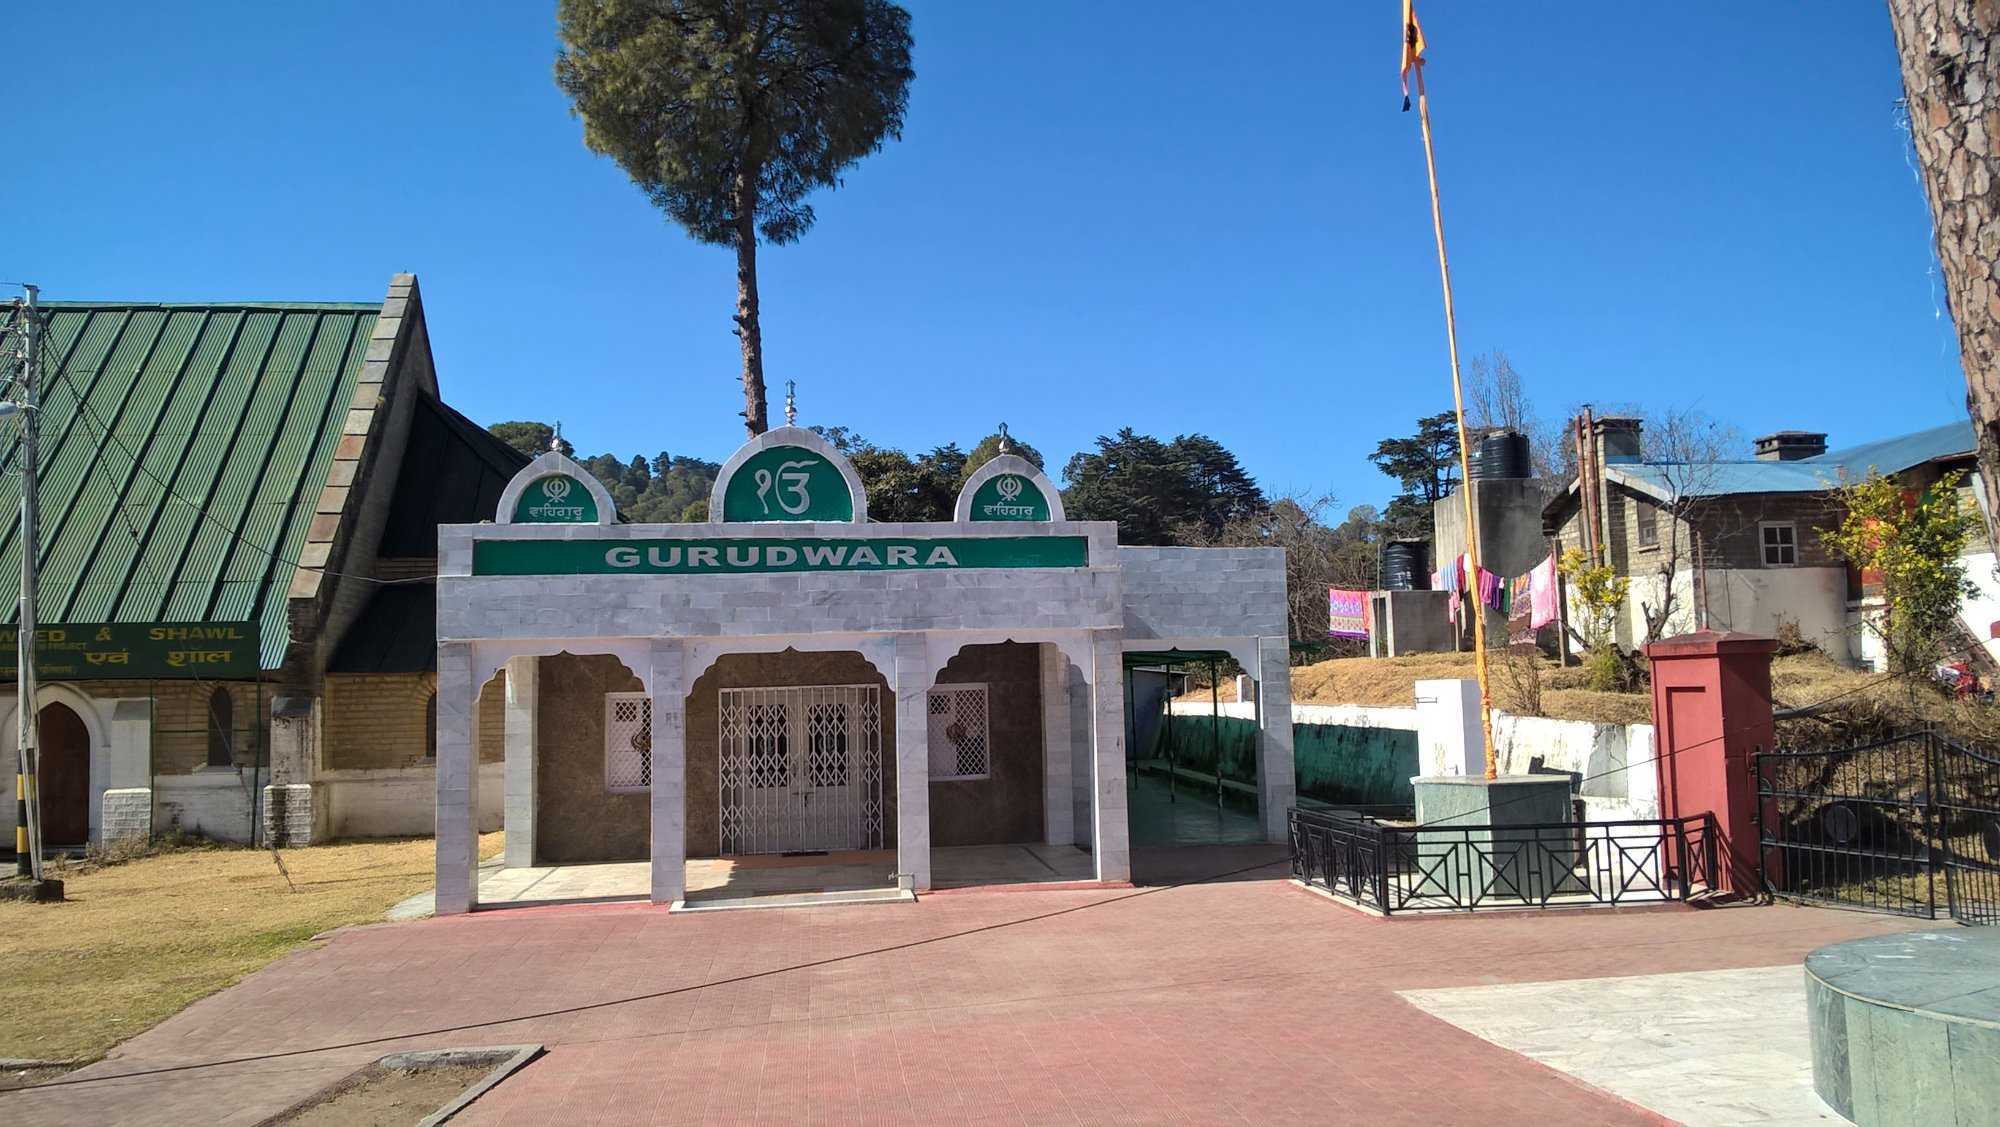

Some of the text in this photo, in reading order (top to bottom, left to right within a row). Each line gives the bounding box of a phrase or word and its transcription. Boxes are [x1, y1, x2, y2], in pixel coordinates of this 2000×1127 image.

[528, 502, 585, 521] ਵਾਹਿਗੁਰੂ
[604, 545, 959, 568] GURUDWARA
[96, 626, 113, 641] &
[149, 627, 244, 640] SHAWL
[84, 648, 130, 665] एवं
